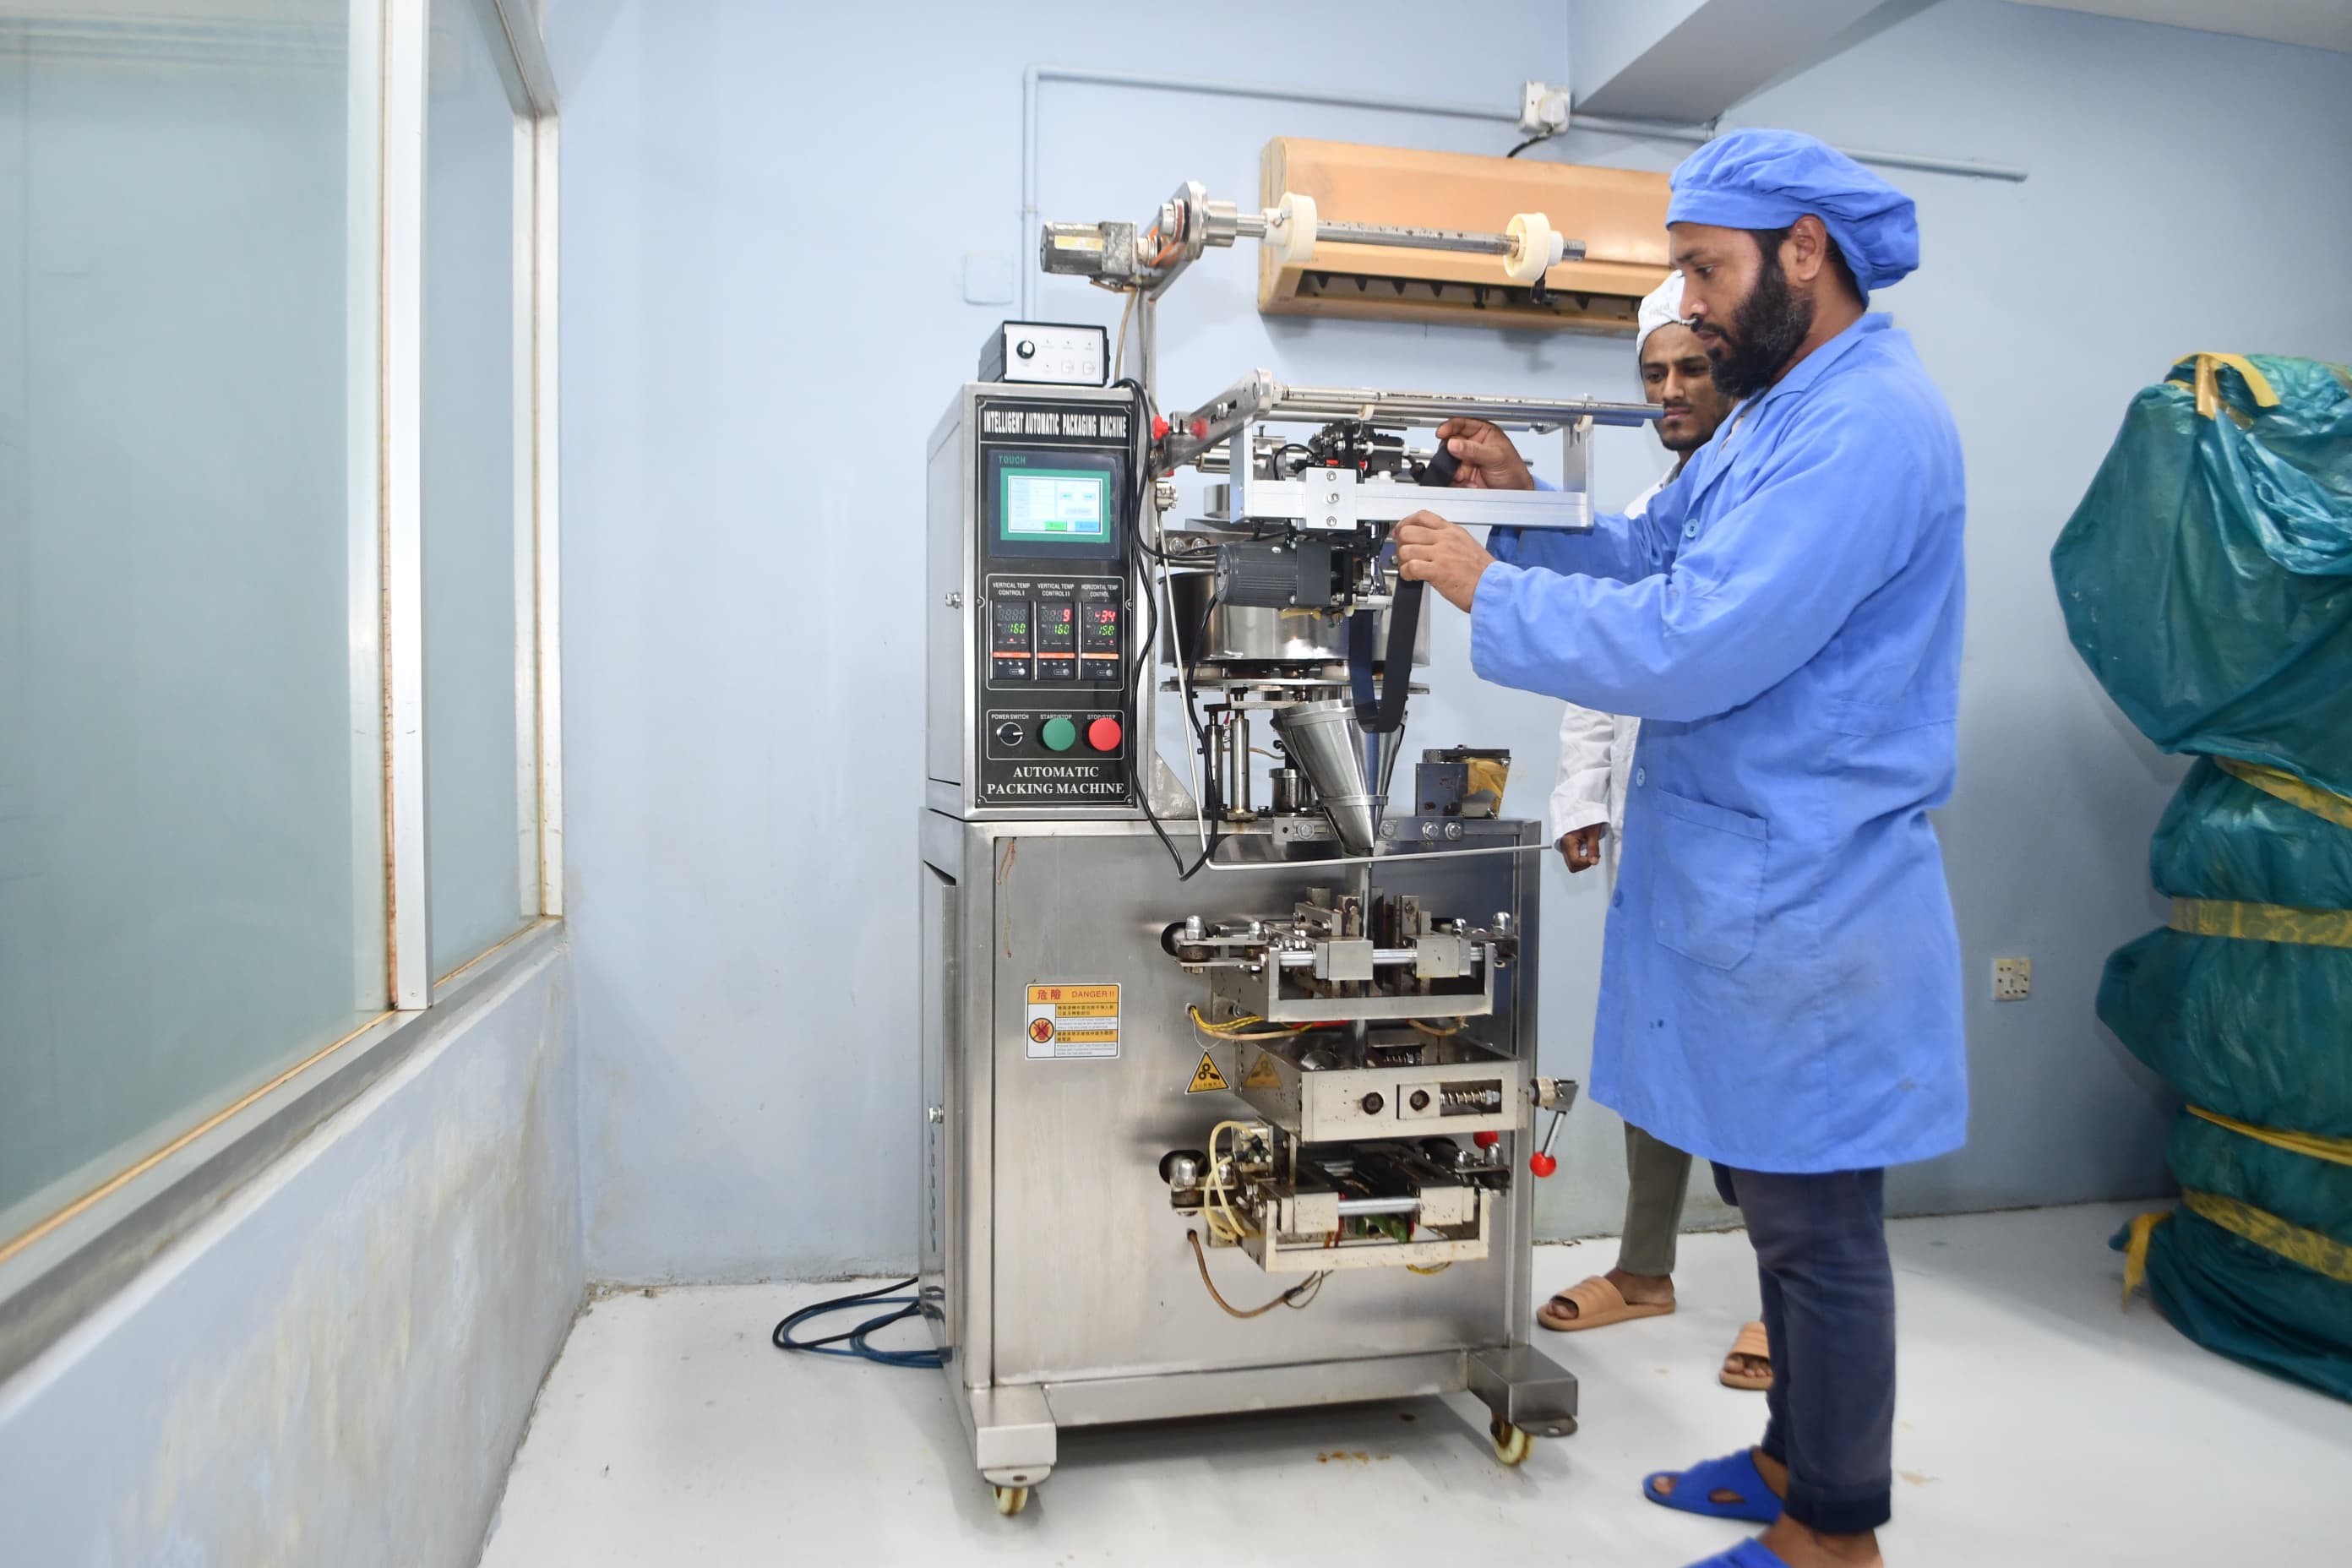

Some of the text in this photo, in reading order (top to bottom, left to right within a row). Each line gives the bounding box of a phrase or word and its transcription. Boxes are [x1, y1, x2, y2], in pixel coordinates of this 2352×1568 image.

[983, 411, 1127, 438] INTELLIGENT AUTOMATIC PACKAGING MACHINE
[999, 455, 1026, 465] TOUCH
[1013, 766, 1100, 778] AUTOMATIC
[987, 783, 1124, 795] PACKING MACHINE
[1037, 988, 1062, 1000] 危險
